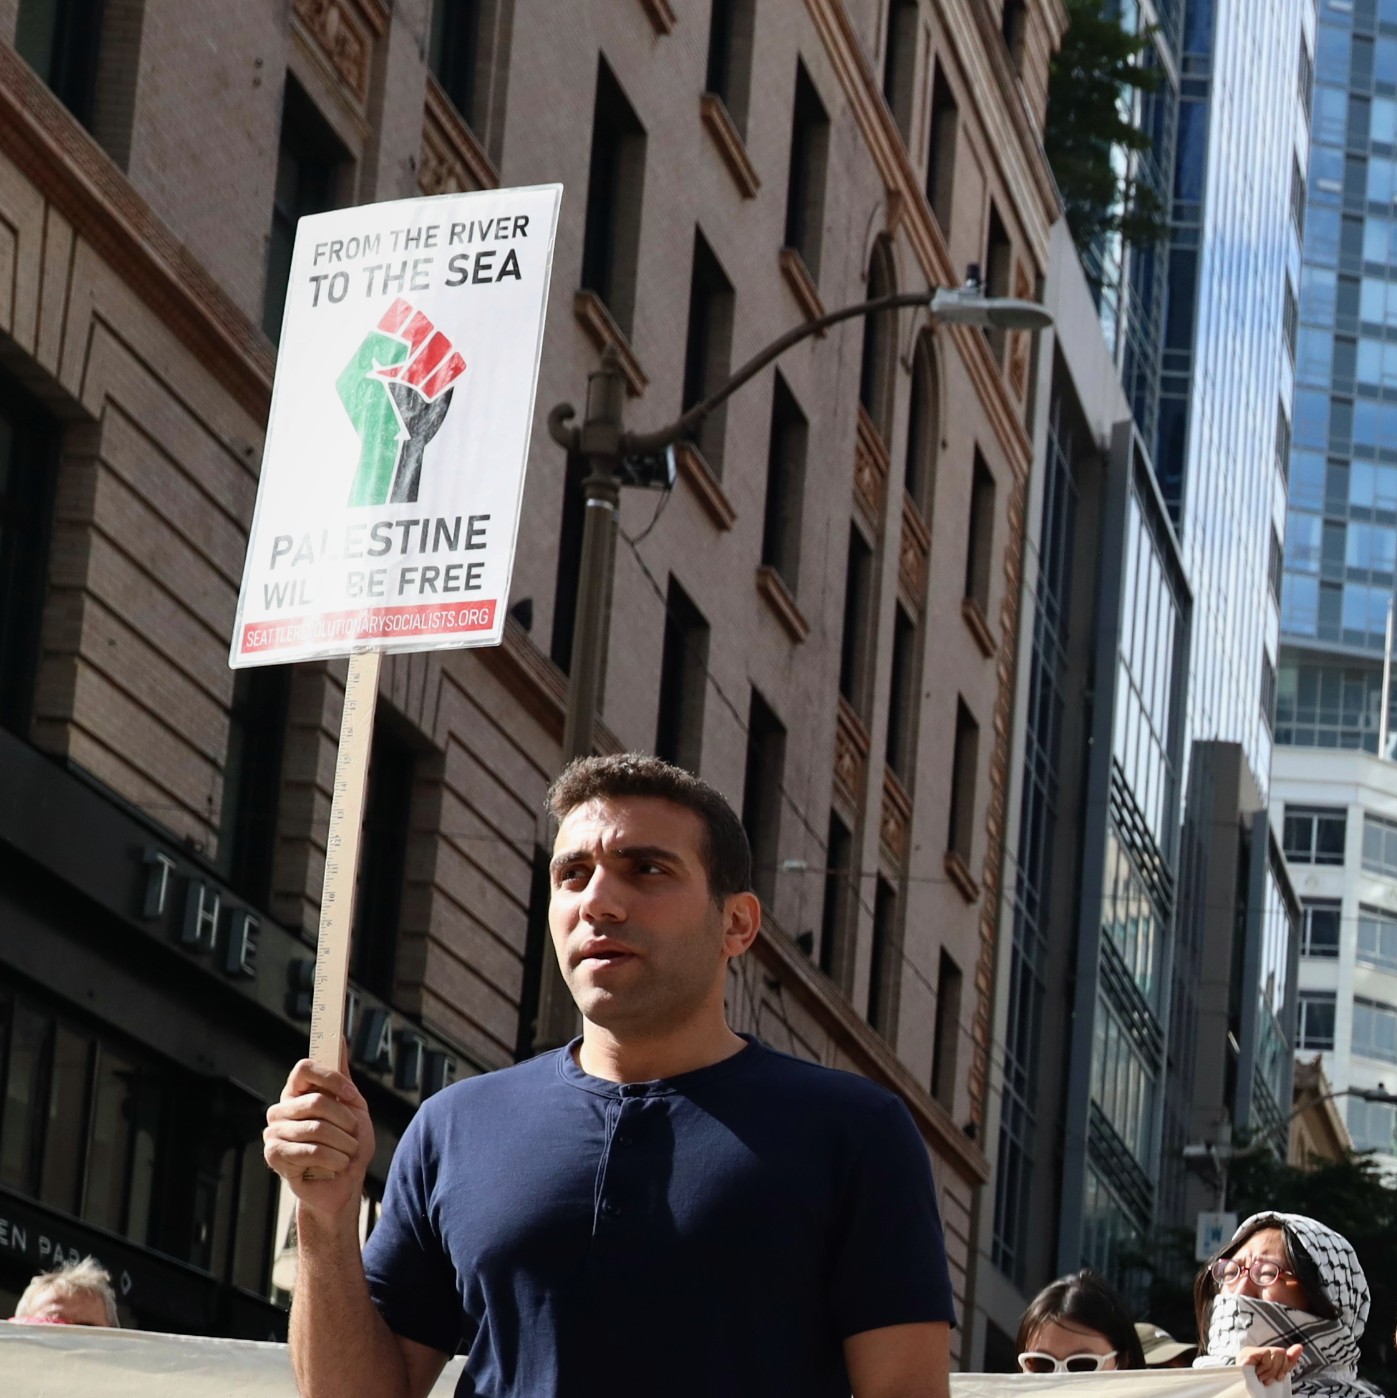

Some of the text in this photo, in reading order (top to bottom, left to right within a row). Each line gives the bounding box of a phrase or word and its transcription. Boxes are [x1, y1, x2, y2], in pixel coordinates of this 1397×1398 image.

[313, 214, 529, 266] FROM THE RIVER
[309, 248, 523, 308] TO THE SEA
[269, 513, 491, 571] PALESTINE
[263, 561, 485, 612] WIL BE FREE
[245, 606, 491, 648] SEATTLERVOLUTIONARYSOCIALISTS.ORG
[144, 846, 261, 980] THE
